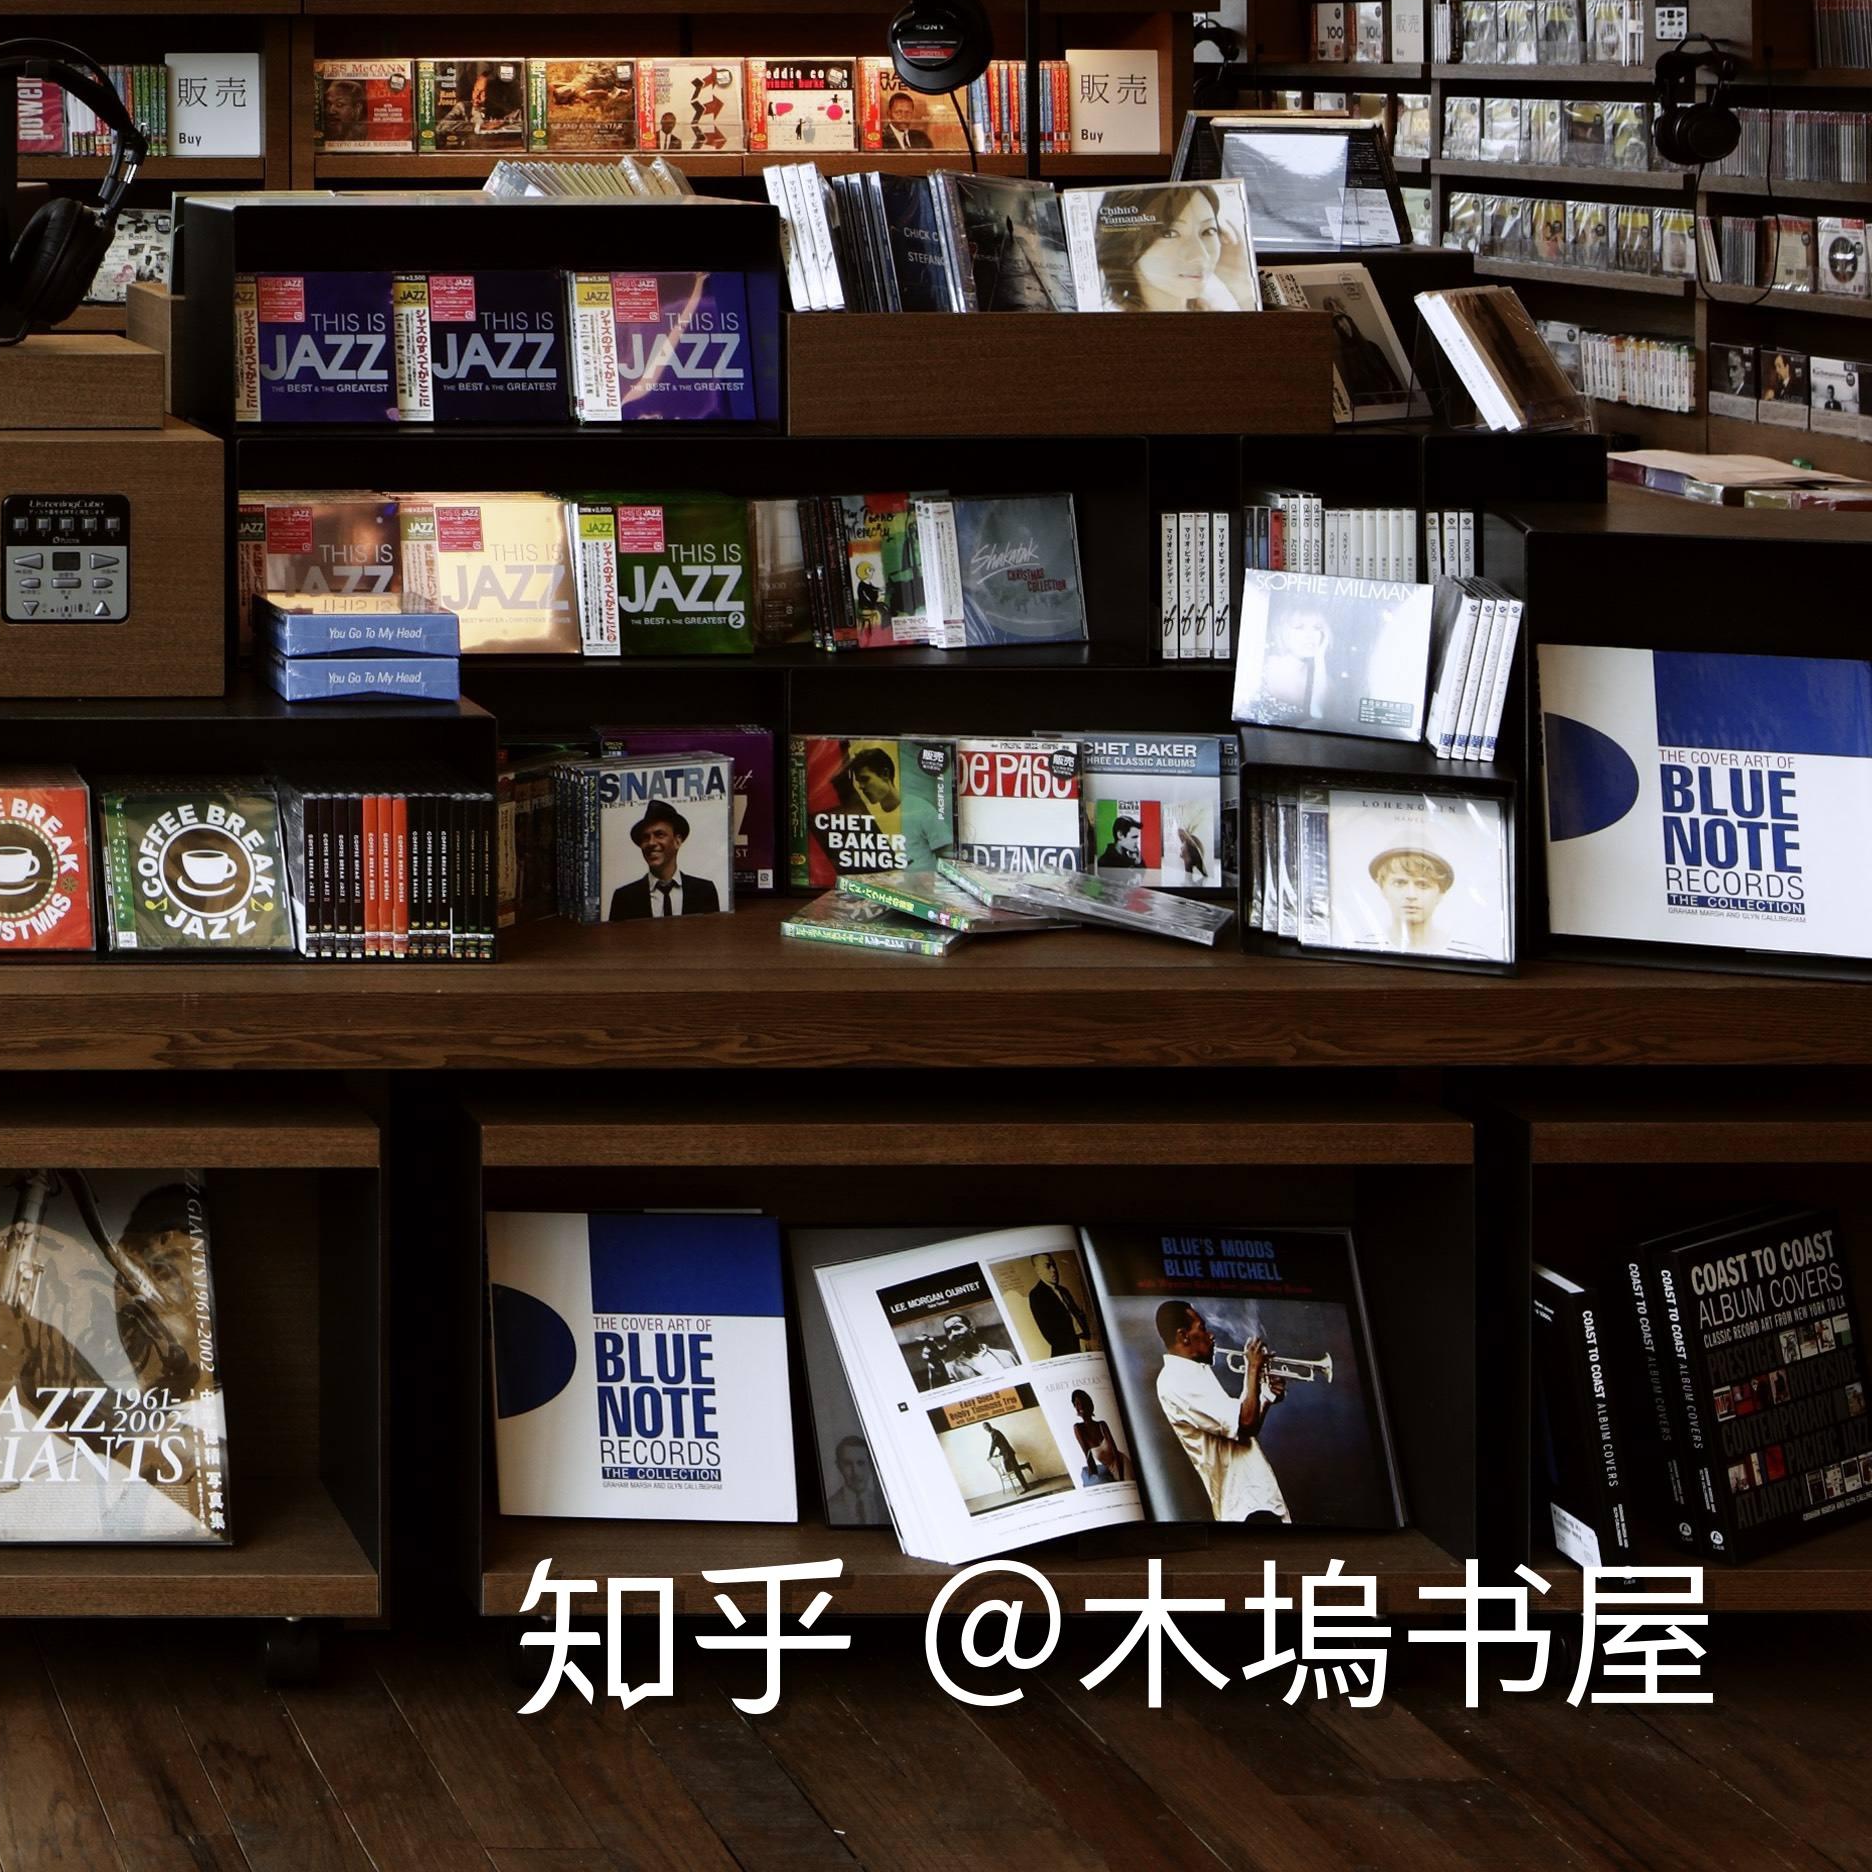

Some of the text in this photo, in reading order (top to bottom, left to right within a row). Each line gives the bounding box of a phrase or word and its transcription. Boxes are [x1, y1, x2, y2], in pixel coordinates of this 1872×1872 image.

[1326, 26, 1344, 39] 100
[176, 76, 248, 109] 販売
[1079, 74, 1148, 105] 販売
[179, 133, 202, 148] Buy
[1081, 129, 1103, 143] Buy
[399, 290, 426, 302] JAZZ
[311, 312, 386, 332] THIS IS
[480, 312, 554, 331] THIS IS
[665, 312, 740, 331] THIS IS
[260, 334, 388, 380] JAZZ
[431, 332, 557, 379] JAZZ
[618, 332, 744, 379] JAZZ
[407, 521, 435, 534] JAZZ
[586, 522, 613, 533] JAZZ
[319, 544, 393, 563] THIS IS
[489, 543, 564, 561] THIS IS
[668, 544, 741, 563] THIS IS
[284, 565, 394, 596] JAZZ
[1007, 568, 1045, 582] CHRISTMAS
[1027, 579, 1067, 592] COLLECTION
[442, 564, 569, 610] JAZZ
[619, 565, 744, 612] JAZZ
[1256, 572, 1419, 603] SOPHIE MILMAN
[644, 617, 664, 625] BEST
[684, 616, 727, 625] GREATEST
[329, 627, 422, 641] You Go To My Head
[328, 672, 421, 686] You Go To My Head
[1083, 742, 1197, 757] CHET BAKER
[1660, 749, 1795, 769] THE COVER ART OF
[1113, 757, 1154, 766] CLASSIC
[1156, 758, 1197, 768] ALBUMS
[599, 765, 727, 803] SINATRA
[1660, 763, 1798, 821] BLUE
[1362, 799, 1457, 814] LOHENGIN
[814, 814, 876, 831] CHET
[10, 797, 80, 874] BREAK
[828, 833, 907, 850] BAKER
[1662, 815, 1802, 874] NOTE
[137, 803, 199, 898] COFFEE
[206, 804, 276, 898] BREAK
[839, 852, 907, 869] SINGS
[1665, 866, 1805, 900] RECORDS
[1670, 894, 1802, 914] THE COLLECTION
[164, 908, 256, 940] JAZZ
[1161, 1236, 1275, 1259] BLUE'S MOODS
[1163, 1258, 1283, 1281] BLUE MITCHELL
[1690, 1229, 1835, 1297] COAST TO COAST
[187, 1198, 216, 1373] GIANTS 1961-2002
[1699, 1262, 1844, 1330] ALBUM COVERS
[890, 1281, 981, 1314] LEE MORGAN QUINTET
[593, 1316, 712, 1332] THE COVER ART OF
[1703, 1294, 1847, 1349] CLASSIC RECORD ART FROM NEW YORK TO LA
[594, 1331, 716, 1385] BLUE
[113, 1386, 181, 1410] 1961-
[1582, 1309, 1619, 1488] COAST TO COAST ALBUM COVERS
[112, 1410, 182, 1433] 2002
[597, 1385, 719, 1440] NOTE
[600, 1439, 721, 1467] RECORDS
[604, 1467, 719, 1481] THE COLLECTION
[206, 1471, 226, 1530] 写真集
